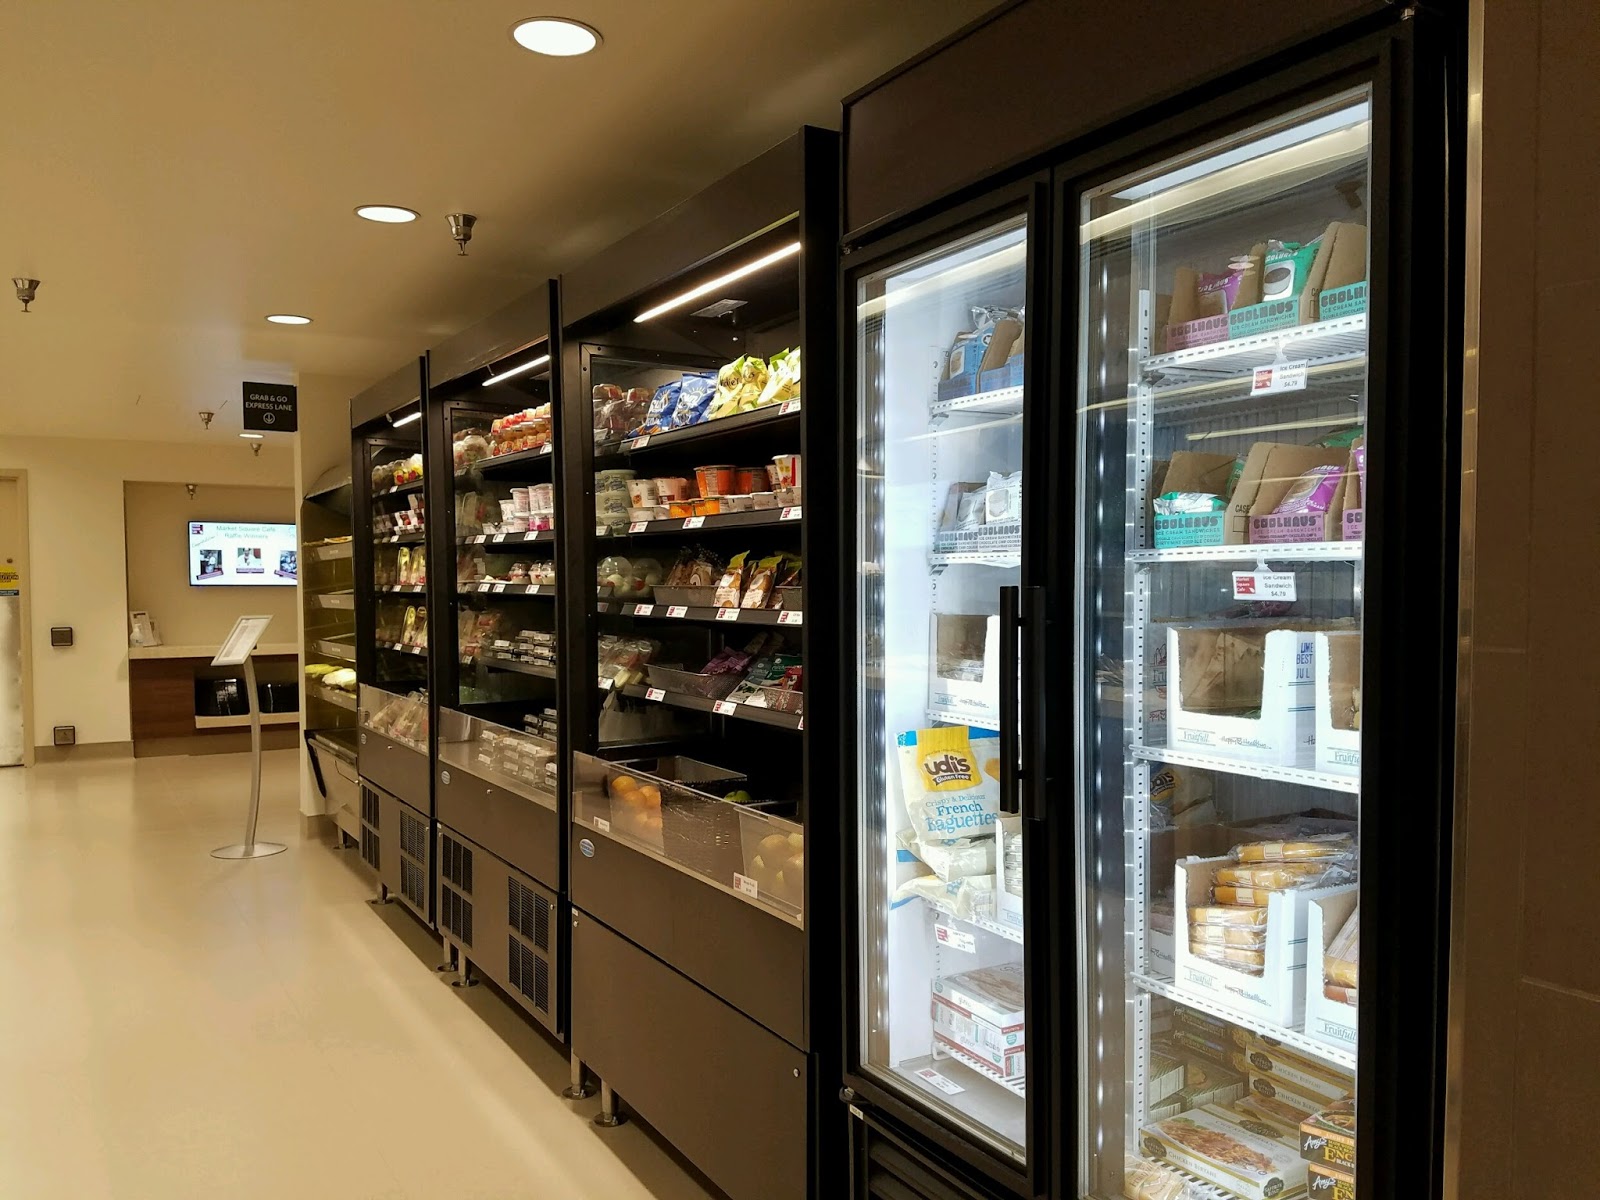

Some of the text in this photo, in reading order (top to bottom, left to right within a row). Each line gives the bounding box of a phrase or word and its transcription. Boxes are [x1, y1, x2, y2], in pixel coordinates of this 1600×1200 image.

[1230, 301, 1294, 326] COOLHAUS
[1260, 313, 1296, 325] SANDWICHES
[1170, 316, 1228, 338] COOLHAUS
[250, 394, 269, 402] GRAB
[245, 402, 293, 412] EXPRESS LANE
[1155, 516, 1219, 531] COOLHAUS
[1253, 515, 1317, 530] COOLHAUS
[1296, 653, 1313, 665] BEST
[924, 754, 971, 776] udi's
[925, 798, 950, 808] Crispy
[958, 793, 986, 801] Delicious
[936, 801, 983, 817] French
[925, 812, 999, 834] Baguettes
